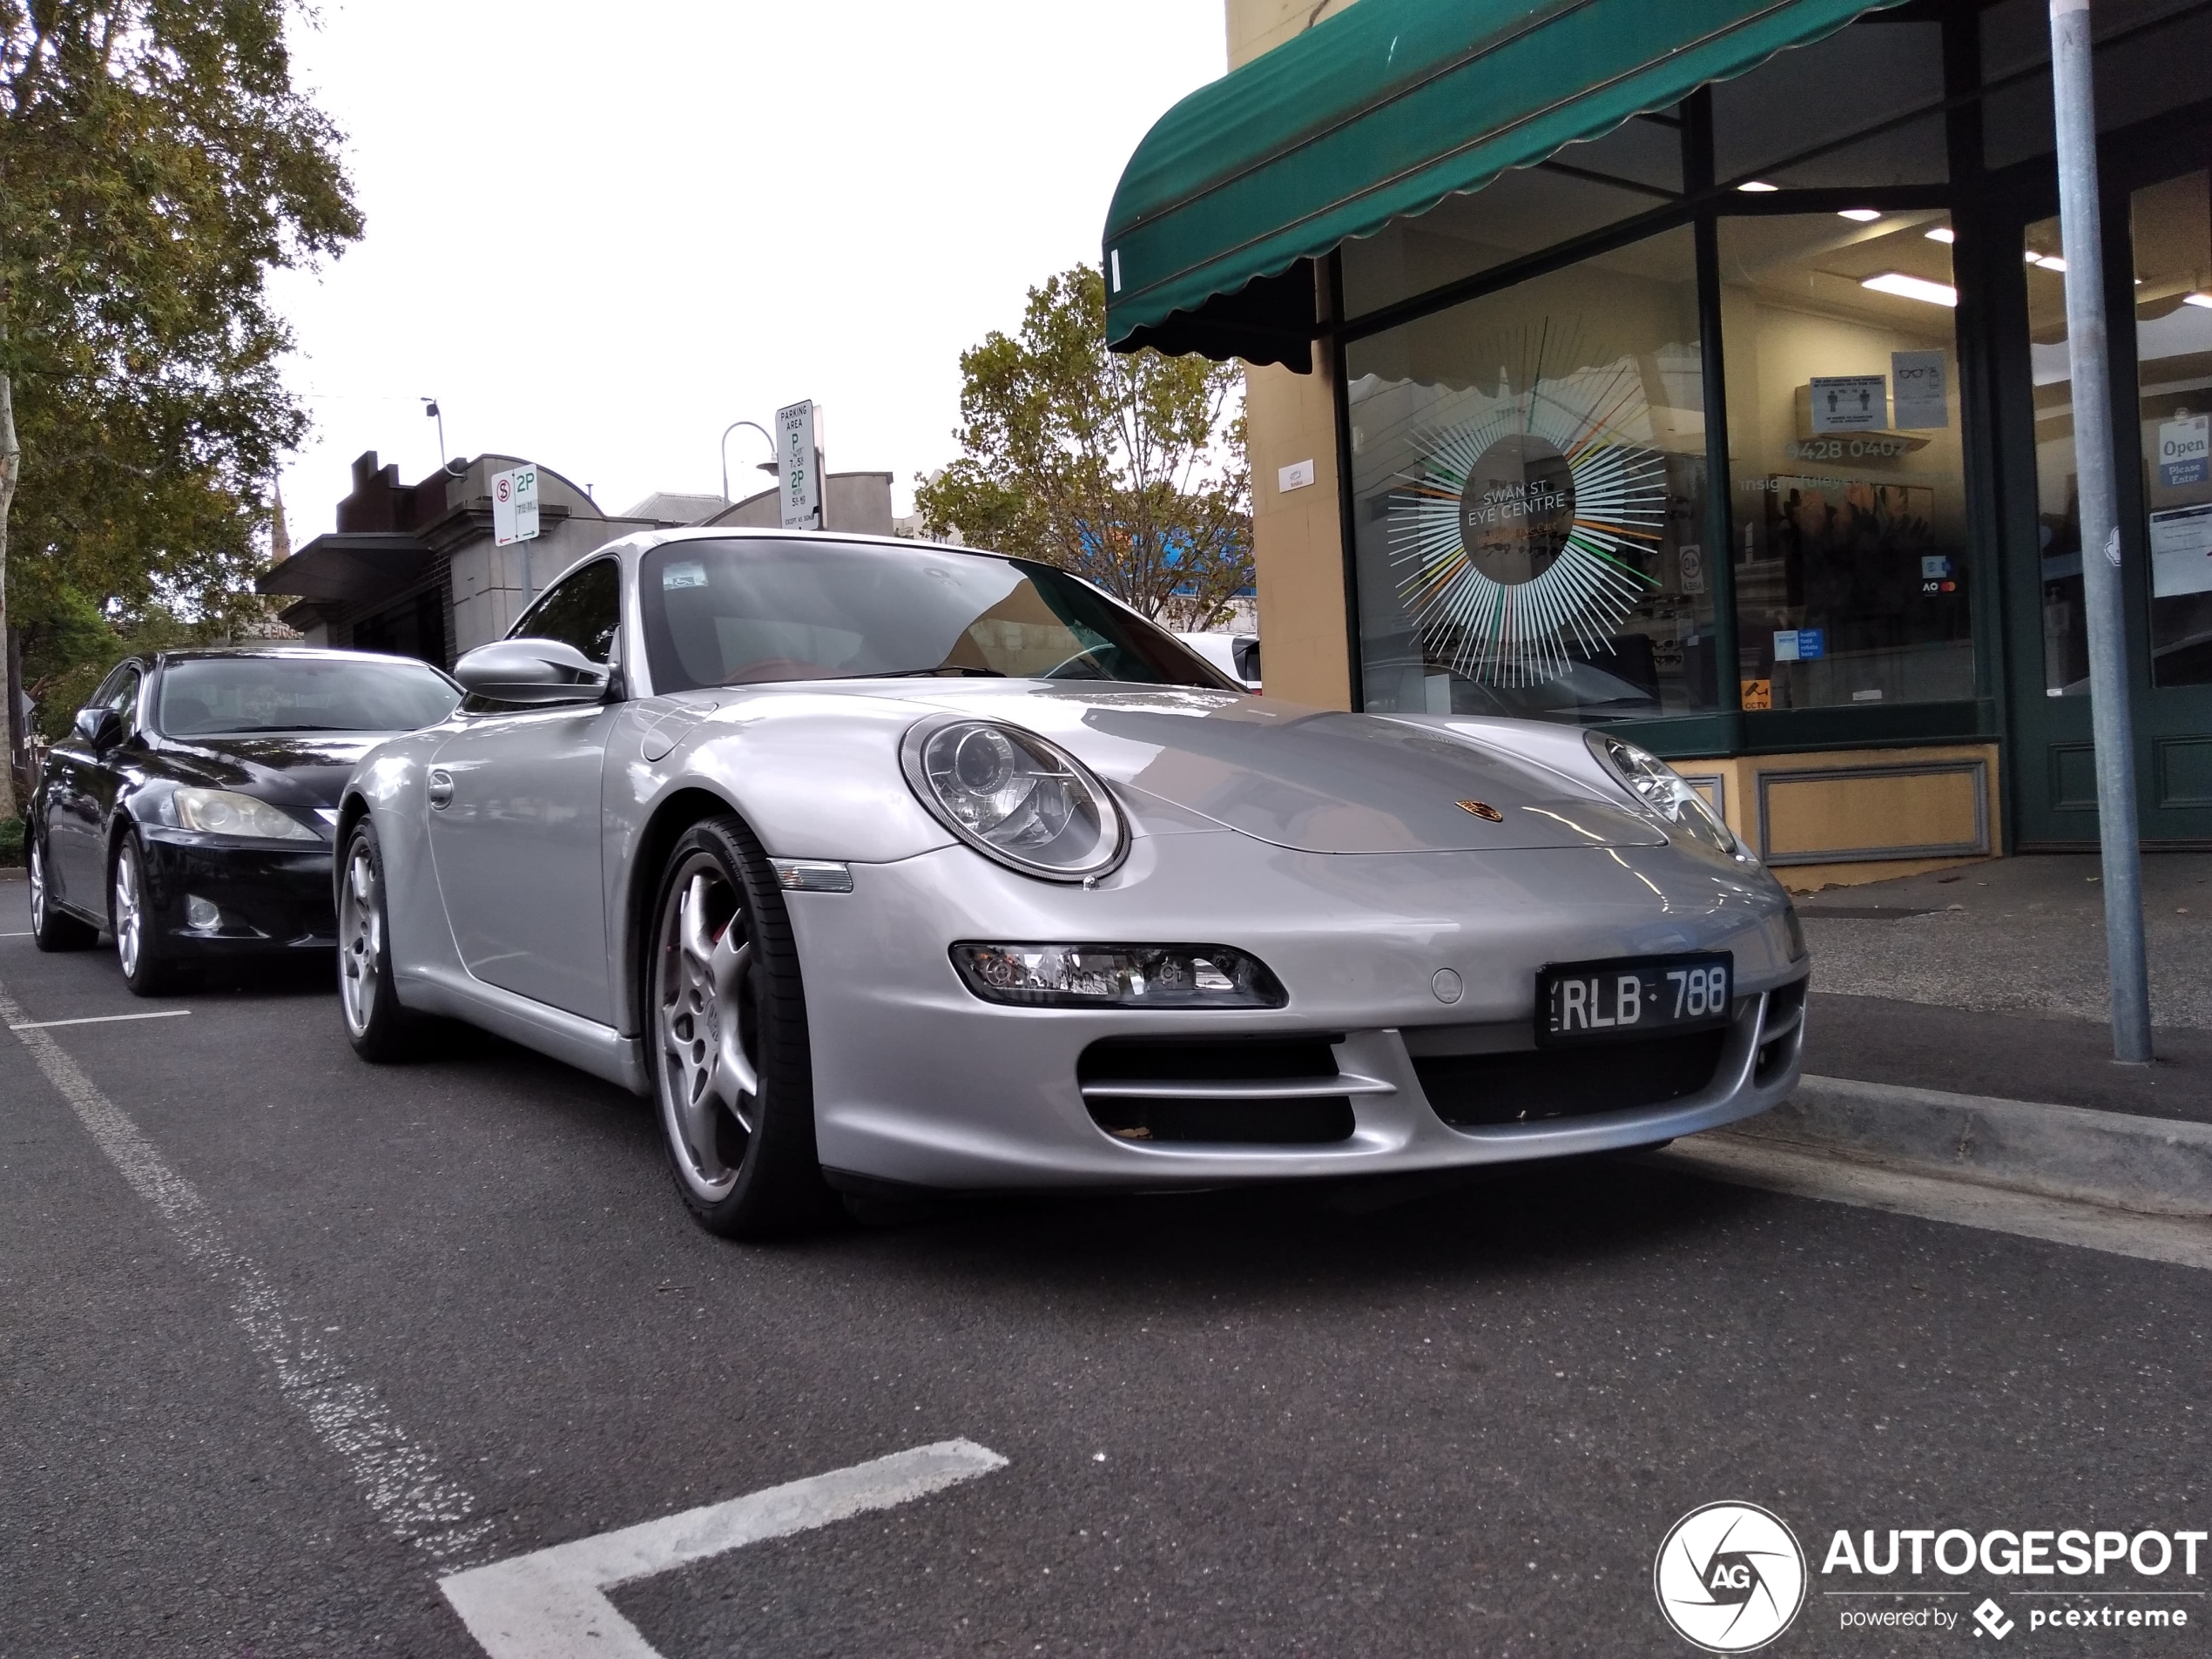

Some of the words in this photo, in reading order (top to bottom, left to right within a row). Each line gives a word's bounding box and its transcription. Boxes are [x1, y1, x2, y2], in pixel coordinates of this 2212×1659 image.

[780, 405, 807, 421] PARKING
[786, 418, 803, 431] AREA
[792, 433, 799, 451] P
[2163, 440, 2205, 457] Open
[2168, 464, 2201, 475] Please
[516, 472, 535, 493] 2P
[791, 469, 804, 489] 2P
[2171, 475, 2199, 485] Enter
[1483, 484, 1525, 506] SWAN
[1530, 479, 1547, 495] ST
[1468, 508, 1496, 527] EYE
[1501, 493, 1566, 519] CENTRE
[1536, 522, 1558, 533] Care
[1562, 975, 1641, 1031] RLB
[1666, 967, 1726, 1019] 788
